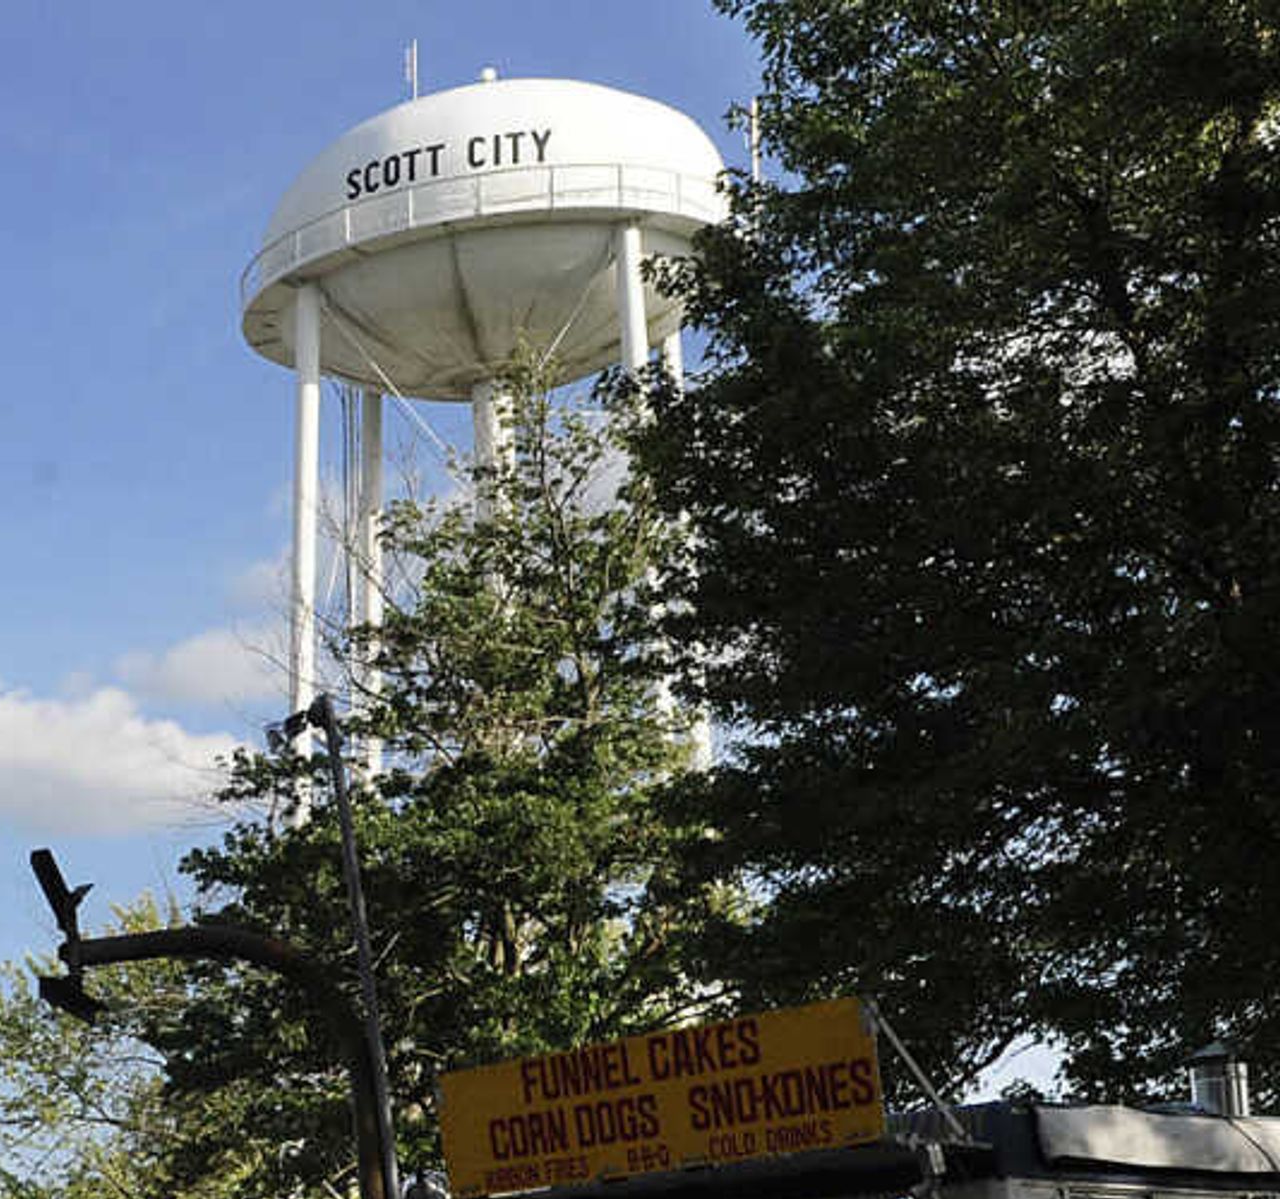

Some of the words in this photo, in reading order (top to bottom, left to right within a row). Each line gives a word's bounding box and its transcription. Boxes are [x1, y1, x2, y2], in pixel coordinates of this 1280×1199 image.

[346, 144, 445, 200] SCOTT
[468, 130, 552, 168] CITY
[521, 1041, 642, 1104] FUNNEL
[647, 1018, 762, 1082] CAKES
[489, 1105, 572, 1161] CORN
[573, 1094, 661, 1149] DOGS
[690, 1057, 875, 1131] SNO-KONES
[708, 1132, 757, 1160] COLD
[766, 1119, 833, 1152] DRINKS
